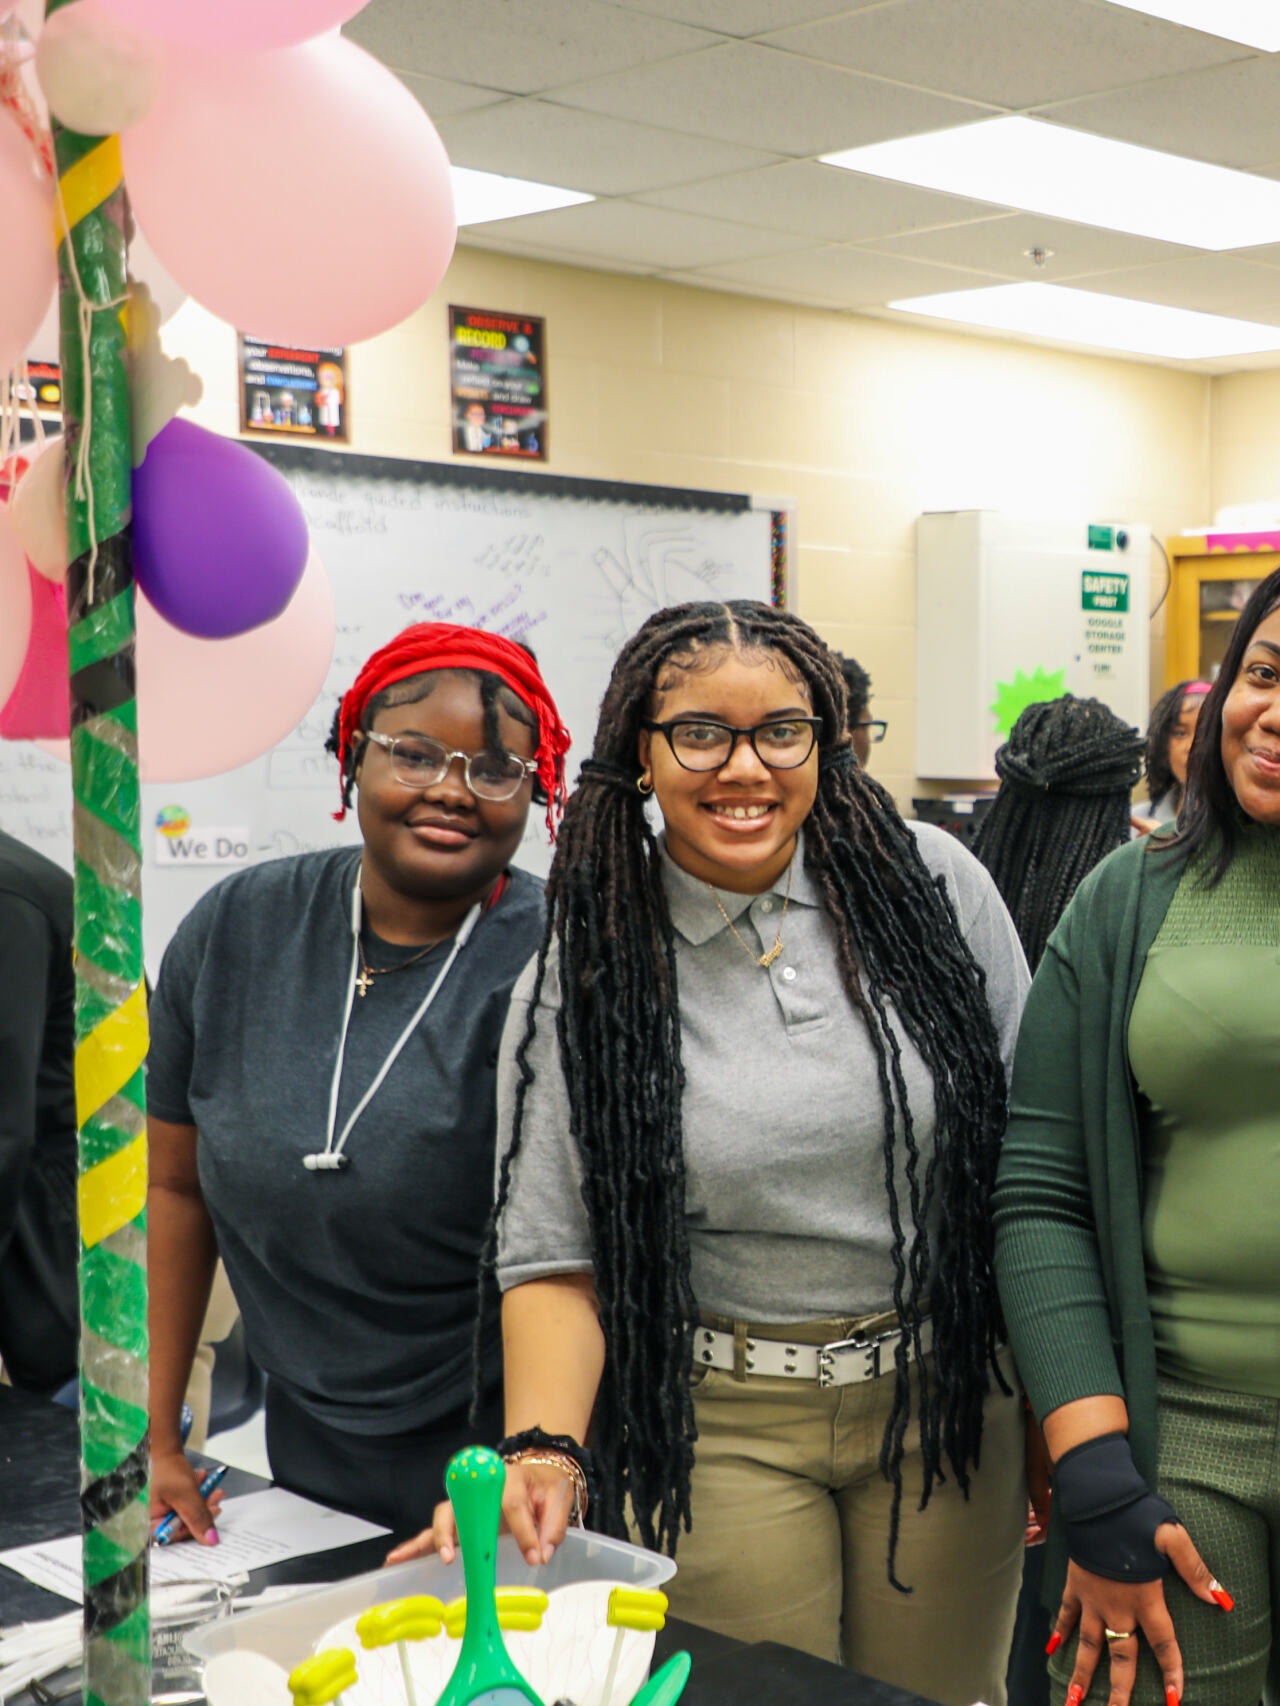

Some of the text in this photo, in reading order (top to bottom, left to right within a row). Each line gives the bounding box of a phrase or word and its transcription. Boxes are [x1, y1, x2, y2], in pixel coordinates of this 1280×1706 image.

[467, 315, 520, 333] OBSERVE
[456, 326, 507, 351] RECORD
[245, 373, 266, 385] and
[1084, 574, 1128, 595] SAFETY
[1093, 595, 1118, 609] FIRST
[1088, 618, 1123, 628] GOGGLE
[1085, 630, 1125, 641] STORAGE
[1088, 643, 1123, 654] CENTER
[168, 838, 207, 859] We
[216, 838, 248, 859] Do
